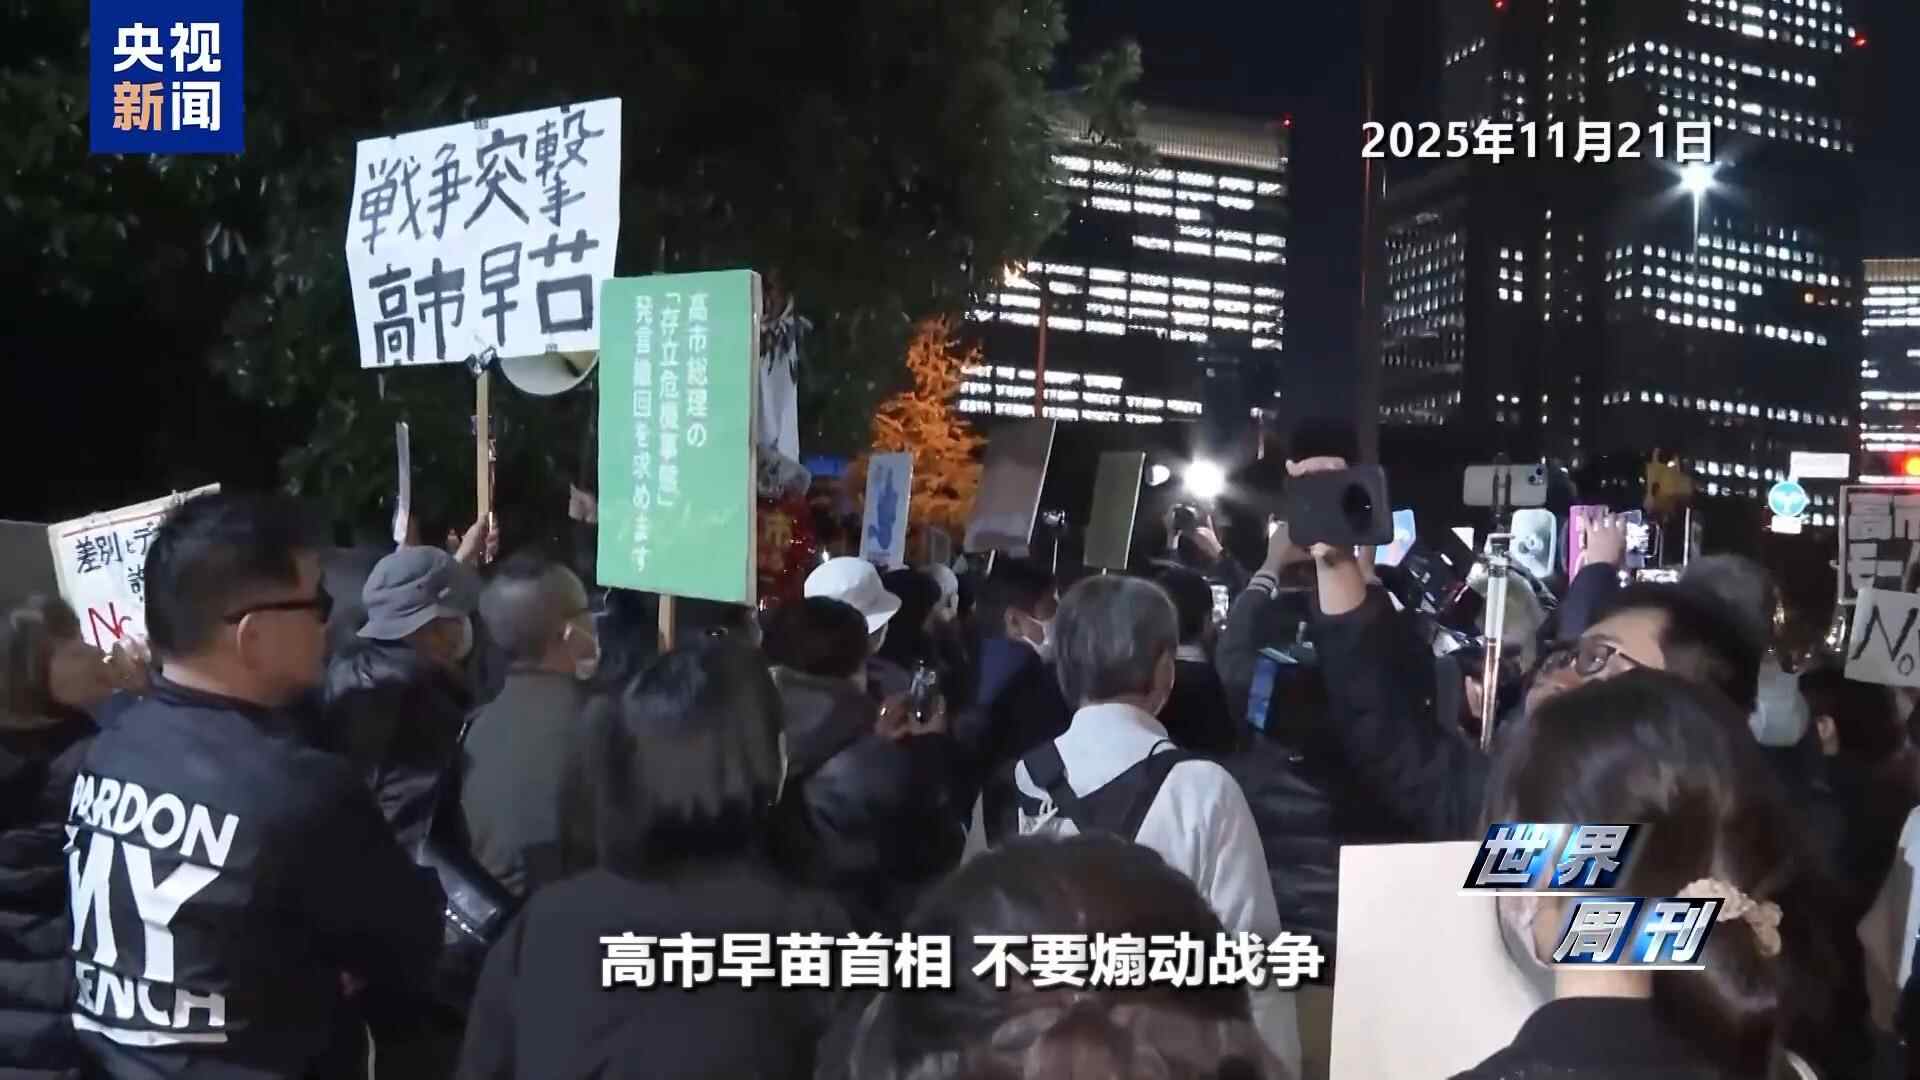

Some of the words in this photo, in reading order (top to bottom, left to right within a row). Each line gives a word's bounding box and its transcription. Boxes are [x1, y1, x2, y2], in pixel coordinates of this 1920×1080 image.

[360, 110, 604, 254] 戦争突撃
[68, 772, 239, 867] PARDON
[64, 824, 221, 983] MY
[76, 960, 226, 1028] ENCH
